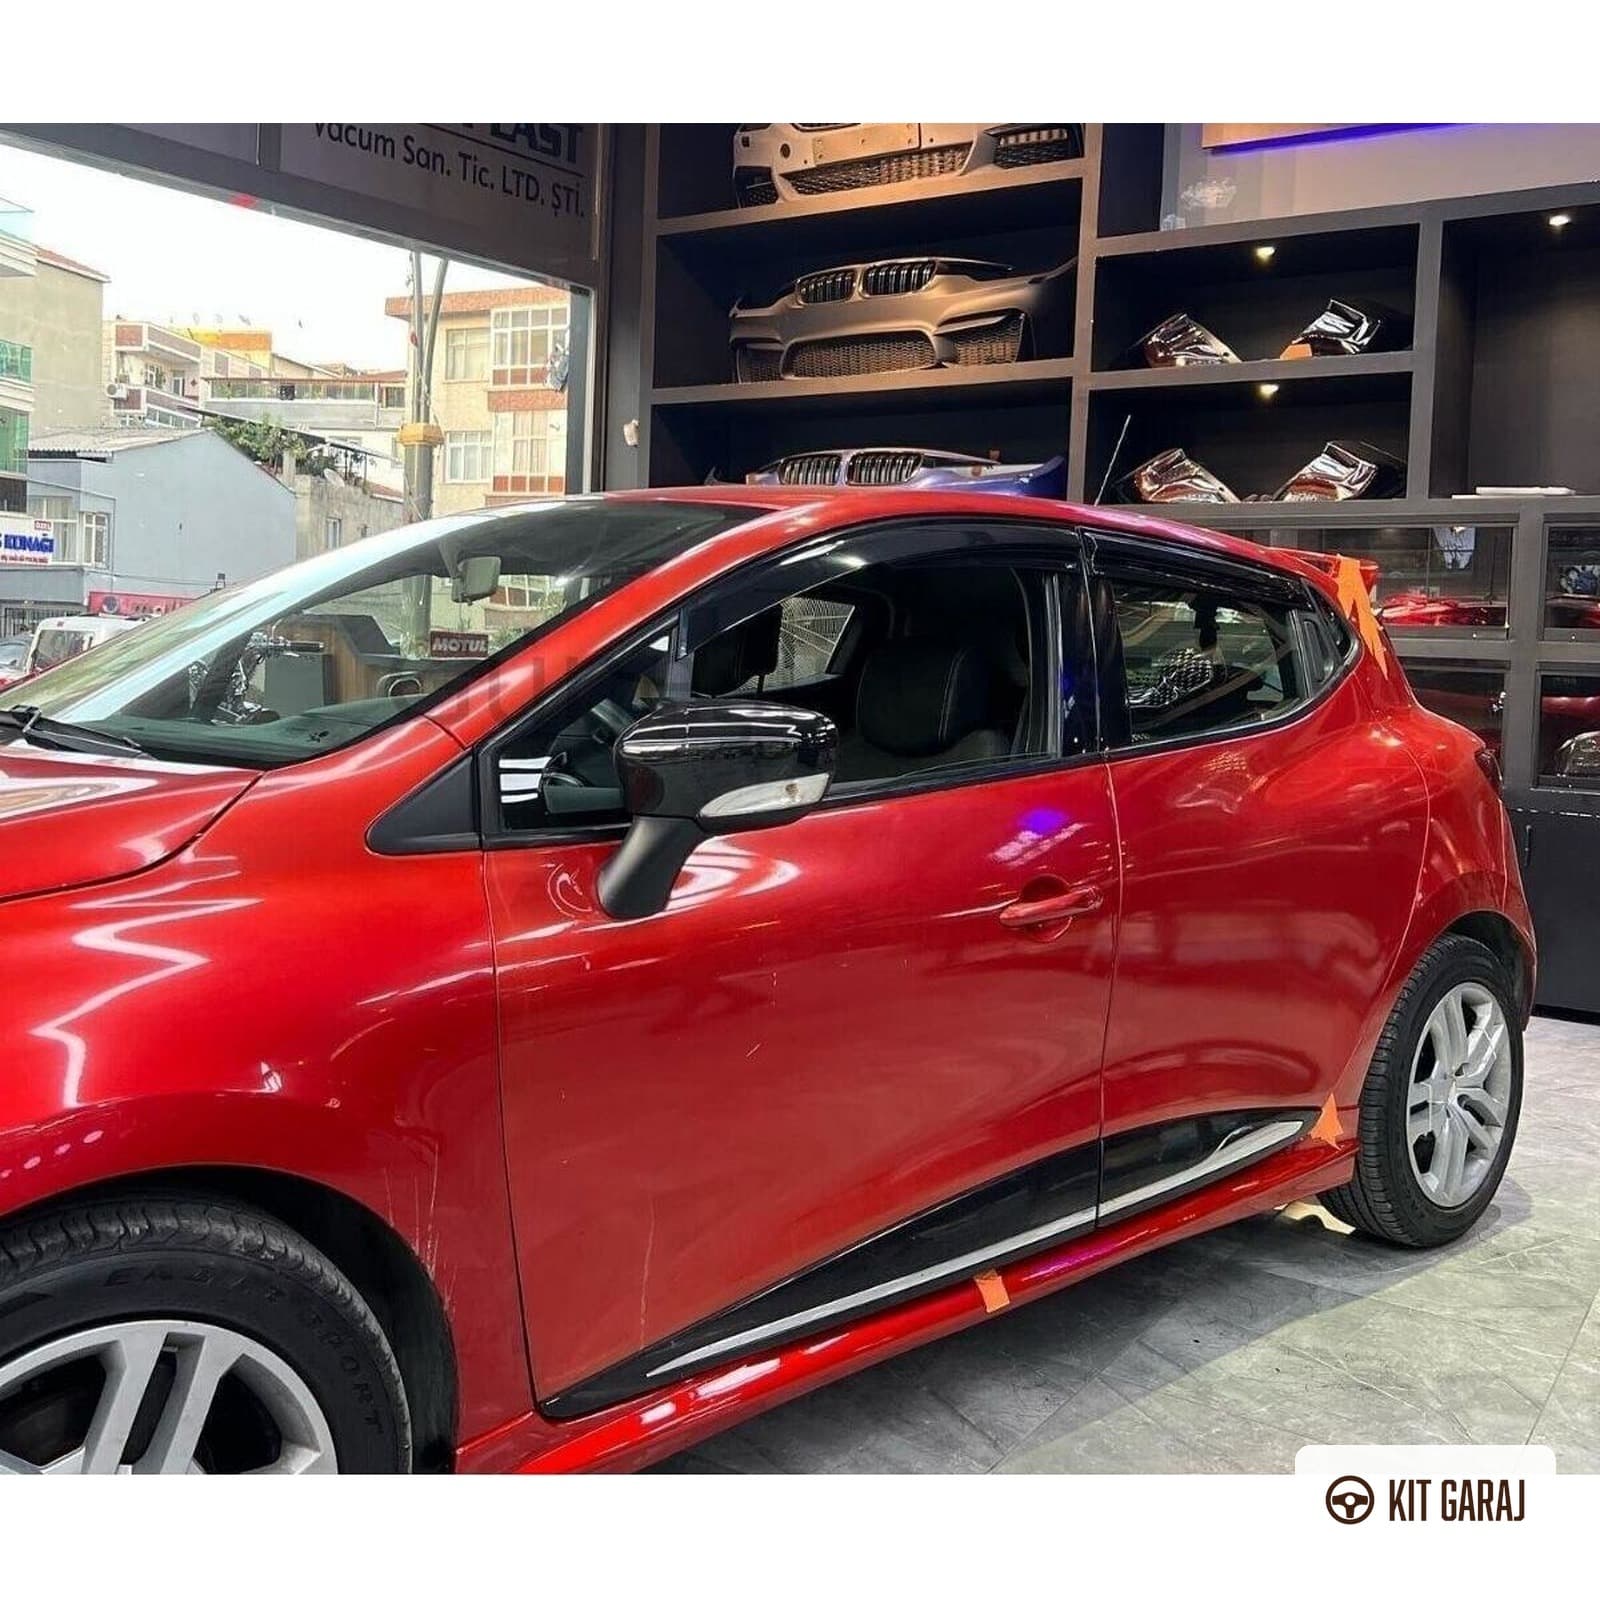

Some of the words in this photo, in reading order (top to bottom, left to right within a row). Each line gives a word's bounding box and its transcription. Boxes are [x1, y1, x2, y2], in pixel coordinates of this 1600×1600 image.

[403, 134, 452, 177] San.
[458, 151, 495, 191] Tic.
[502, 165, 545, 206] LTD.
[551, 181, 585, 218] ŞTİ.
[432, 637, 488, 653] MOTUL
